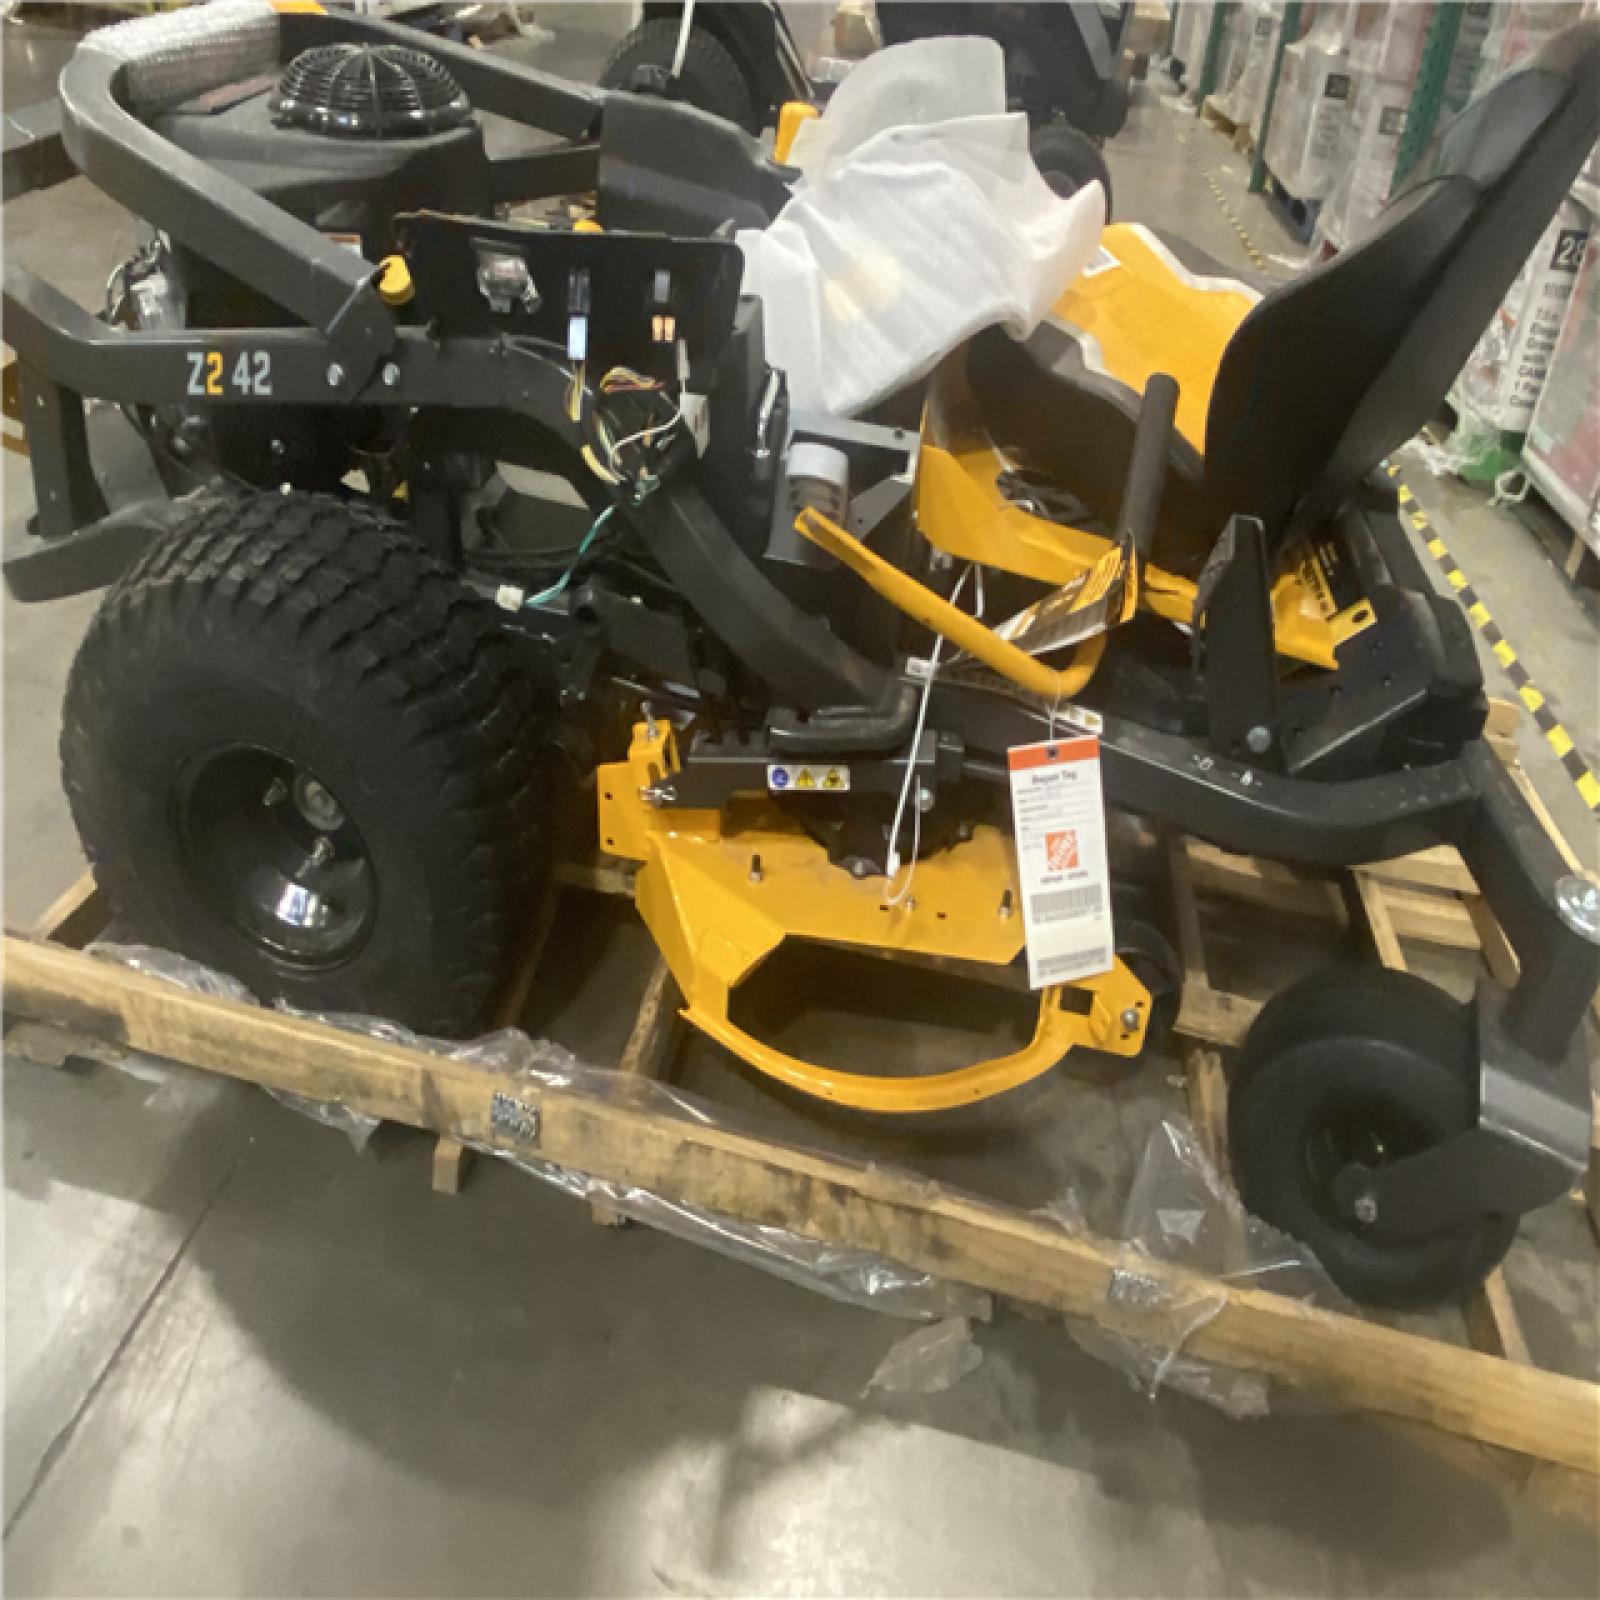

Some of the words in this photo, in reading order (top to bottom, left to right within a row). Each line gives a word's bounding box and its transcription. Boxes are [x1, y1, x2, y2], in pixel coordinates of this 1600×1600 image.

[187, 351, 224, 395] Z2
[232, 350, 272, 395] 42
[1061, 769, 1078, 781] Tag
